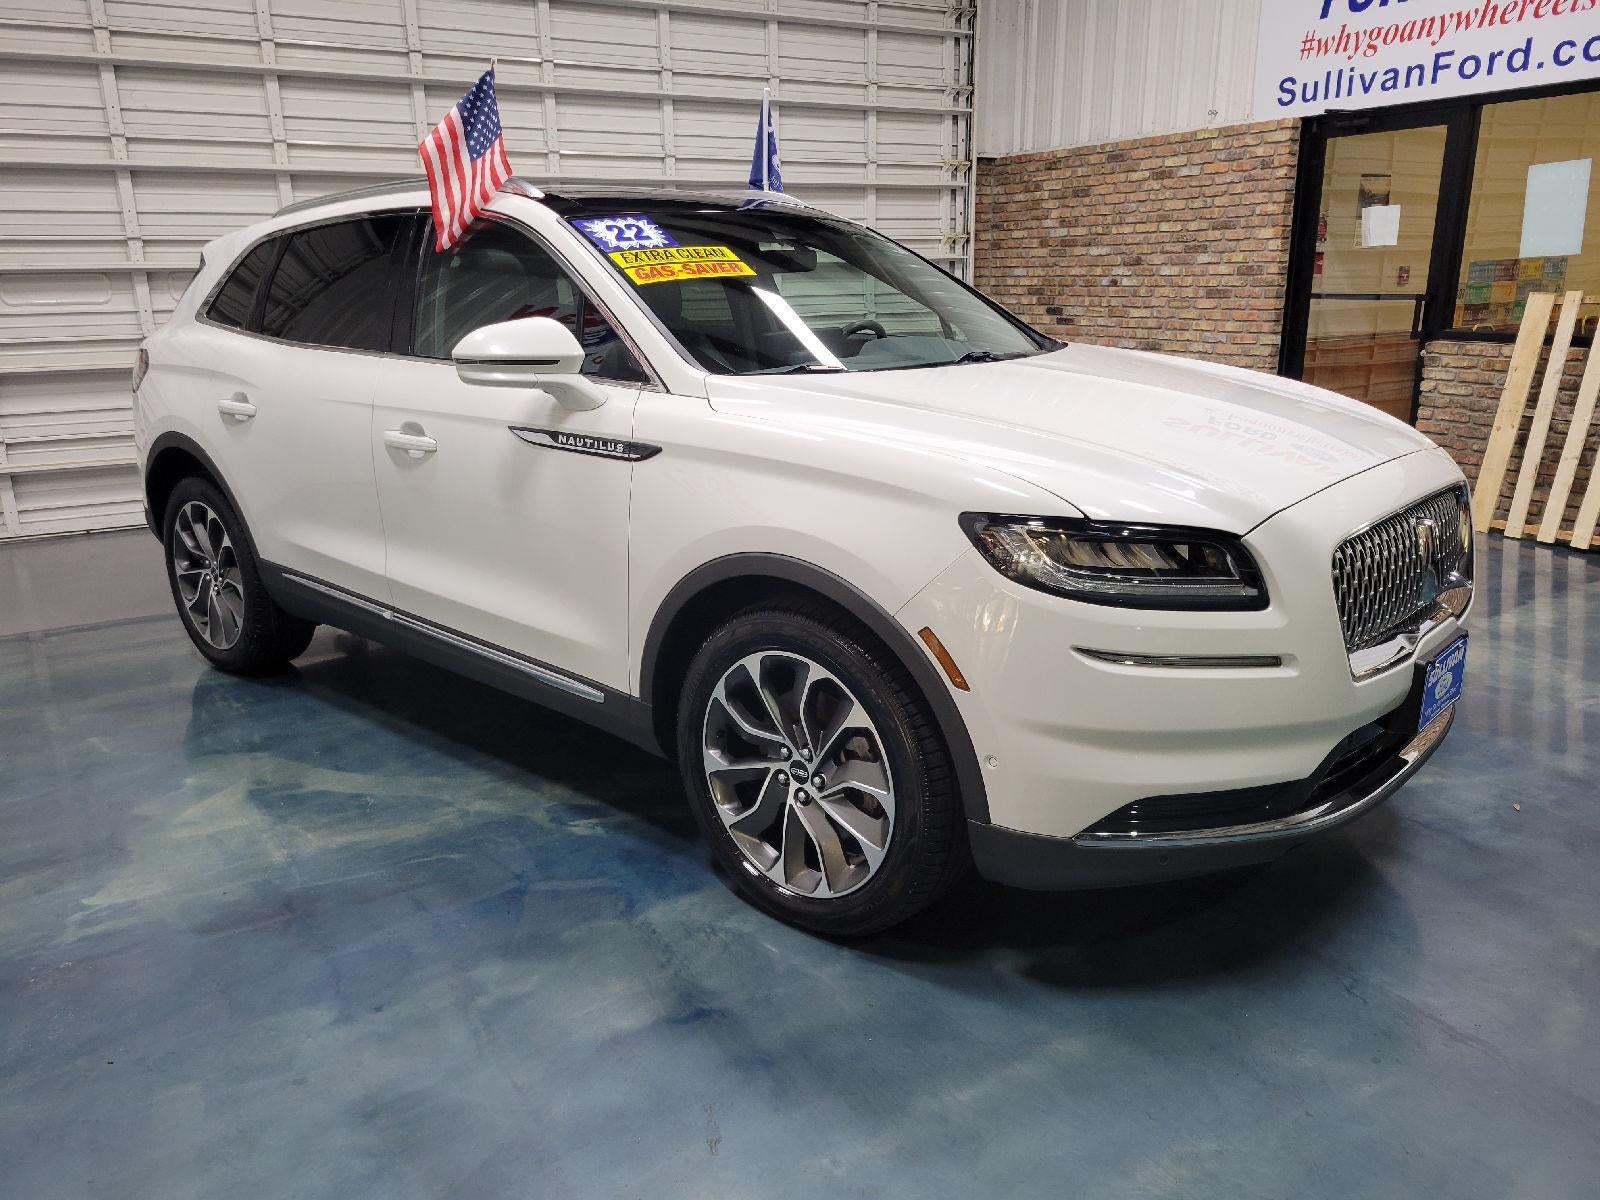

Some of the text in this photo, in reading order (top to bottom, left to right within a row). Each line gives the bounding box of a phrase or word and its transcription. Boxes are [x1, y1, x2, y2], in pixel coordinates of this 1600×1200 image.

[605, 223, 652, 242] 22
[620, 247, 727, 264] EXTRA CLEAN
[634, 262, 745, 280] GAS-SAVER
[558, 434, 625, 453] NAUTILUS
